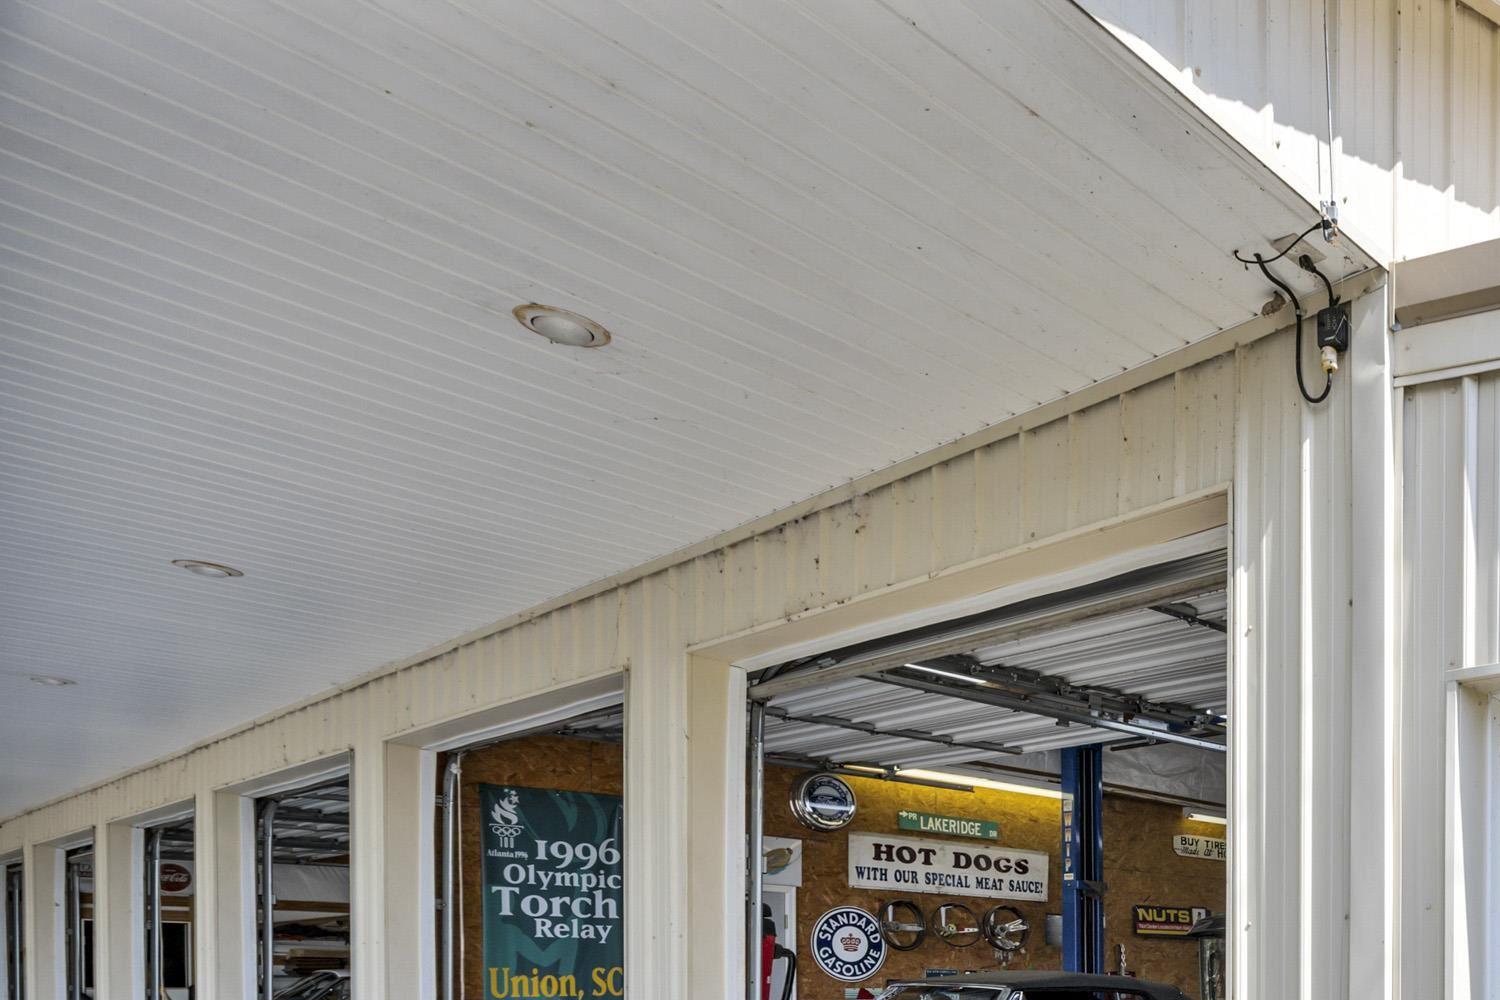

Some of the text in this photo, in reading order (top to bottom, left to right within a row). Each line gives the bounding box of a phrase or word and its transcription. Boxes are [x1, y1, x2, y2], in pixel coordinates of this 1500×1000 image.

[920, 815, 982, 836] LAKERIDGE
[487, 848, 514, 859] Atlanta
[535, 838, 621, 870] 1996
[1180, 836, 1200, 847] BUY
[872, 843, 1030, 875] HOT DOGS
[503, 863, 622, 892] Olympic
[855, 866, 1044, 895] WITH OUR SPECIAL MEAT SAUCE!
[491, 886, 620, 919] Torch
[1138, 907, 1190, 923] NUTS
[534, 918, 613, 944] Relay
[818, 912, 881, 944] STANDARD
[819, 946, 881, 977] GASOLINE
[591, 966, 624, 997] SC
